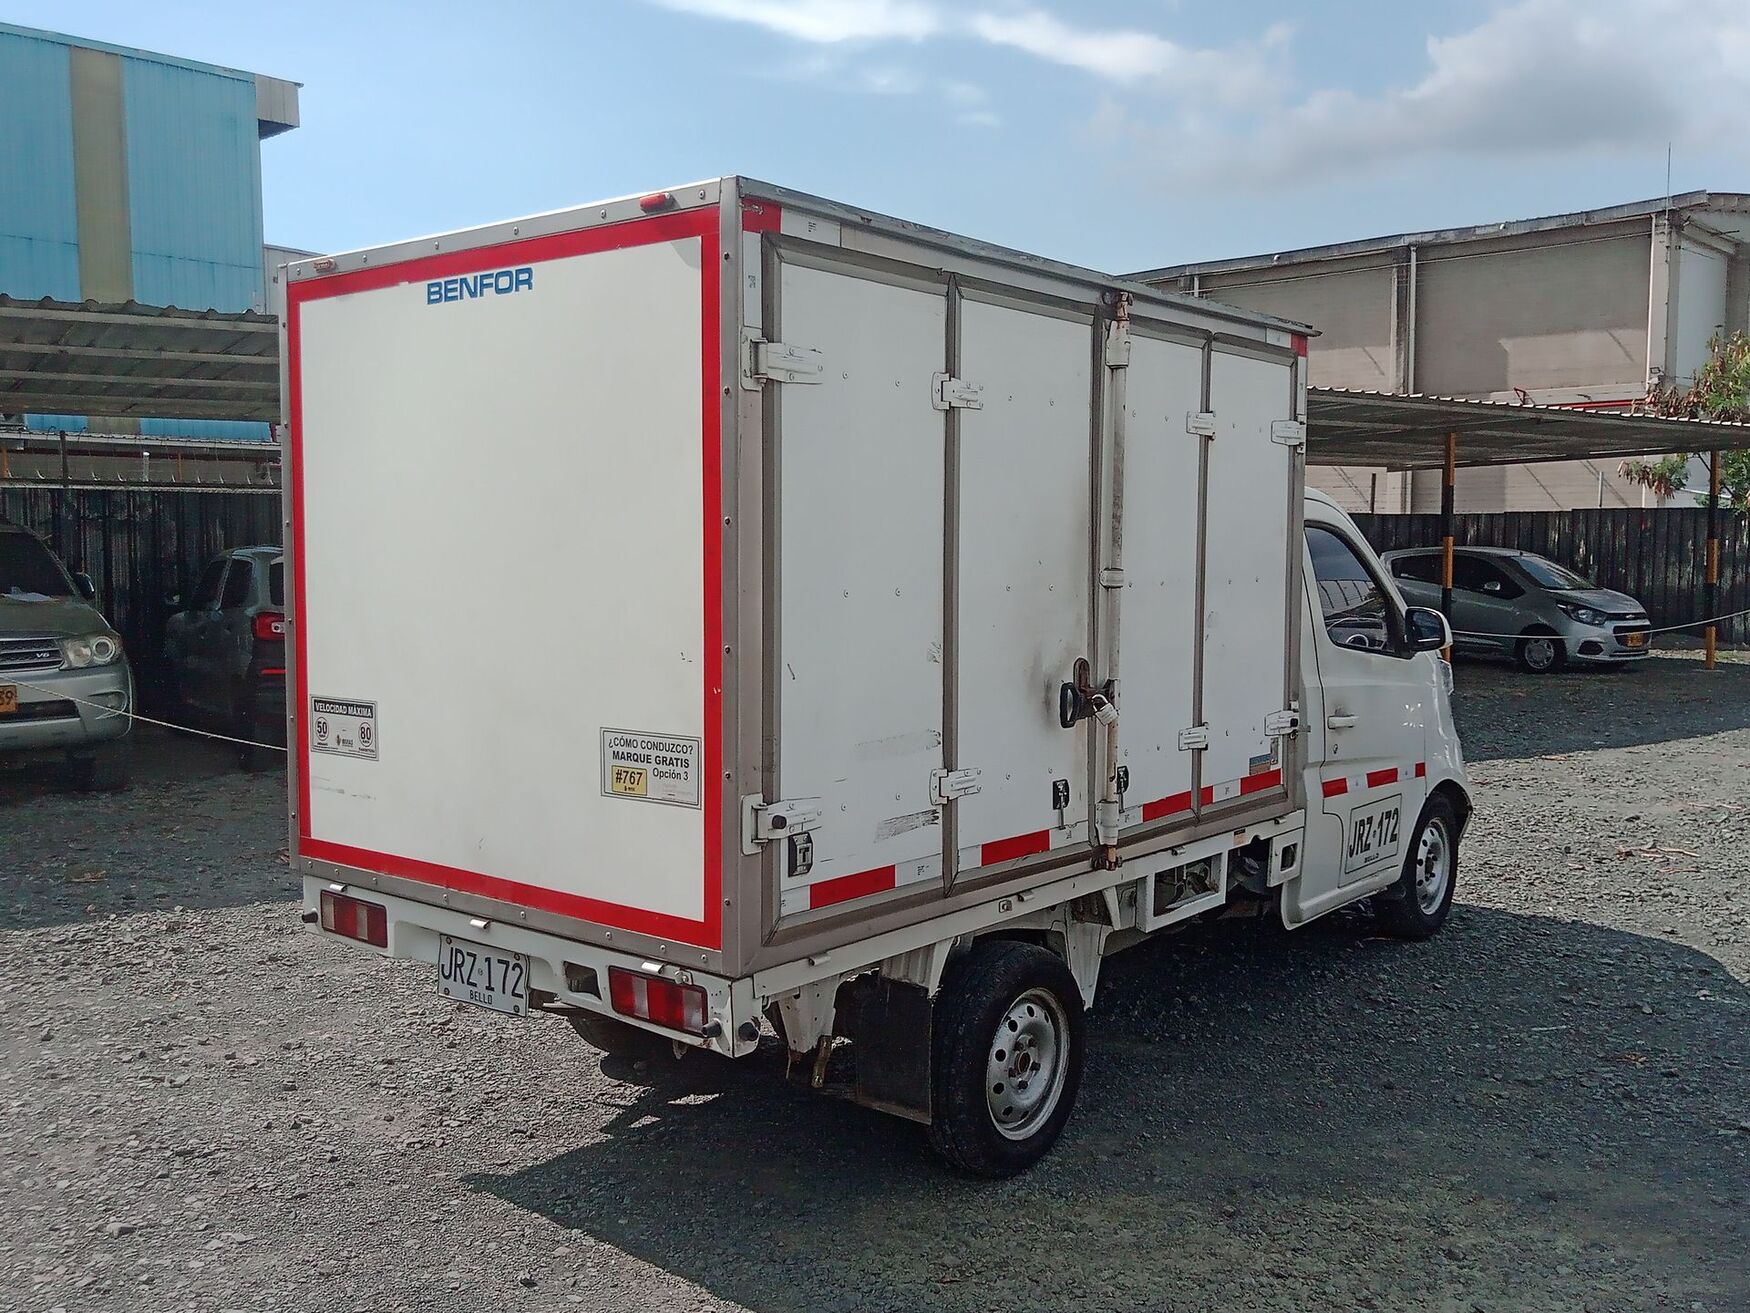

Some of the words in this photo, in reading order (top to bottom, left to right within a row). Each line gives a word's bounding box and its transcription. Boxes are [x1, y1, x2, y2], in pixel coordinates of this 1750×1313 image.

[427, 267, 533, 305] BENFOR
[315, 701, 348, 714] VELOCIDAD
[317, 720, 328, 735] 50
[360, 726, 371, 740] 80
[608, 735, 638, 749] ¿CÓMO
[640, 740, 694, 755] CONDUZCO?
[612, 750, 652, 764] MARQUE
[654, 755, 690, 769] GRATIS
[615, 769, 643, 786] #767
[652, 767, 682, 780] Opción
[683, 771, 689, 781] 3
[469, 989, 493, 1005] BELLO
